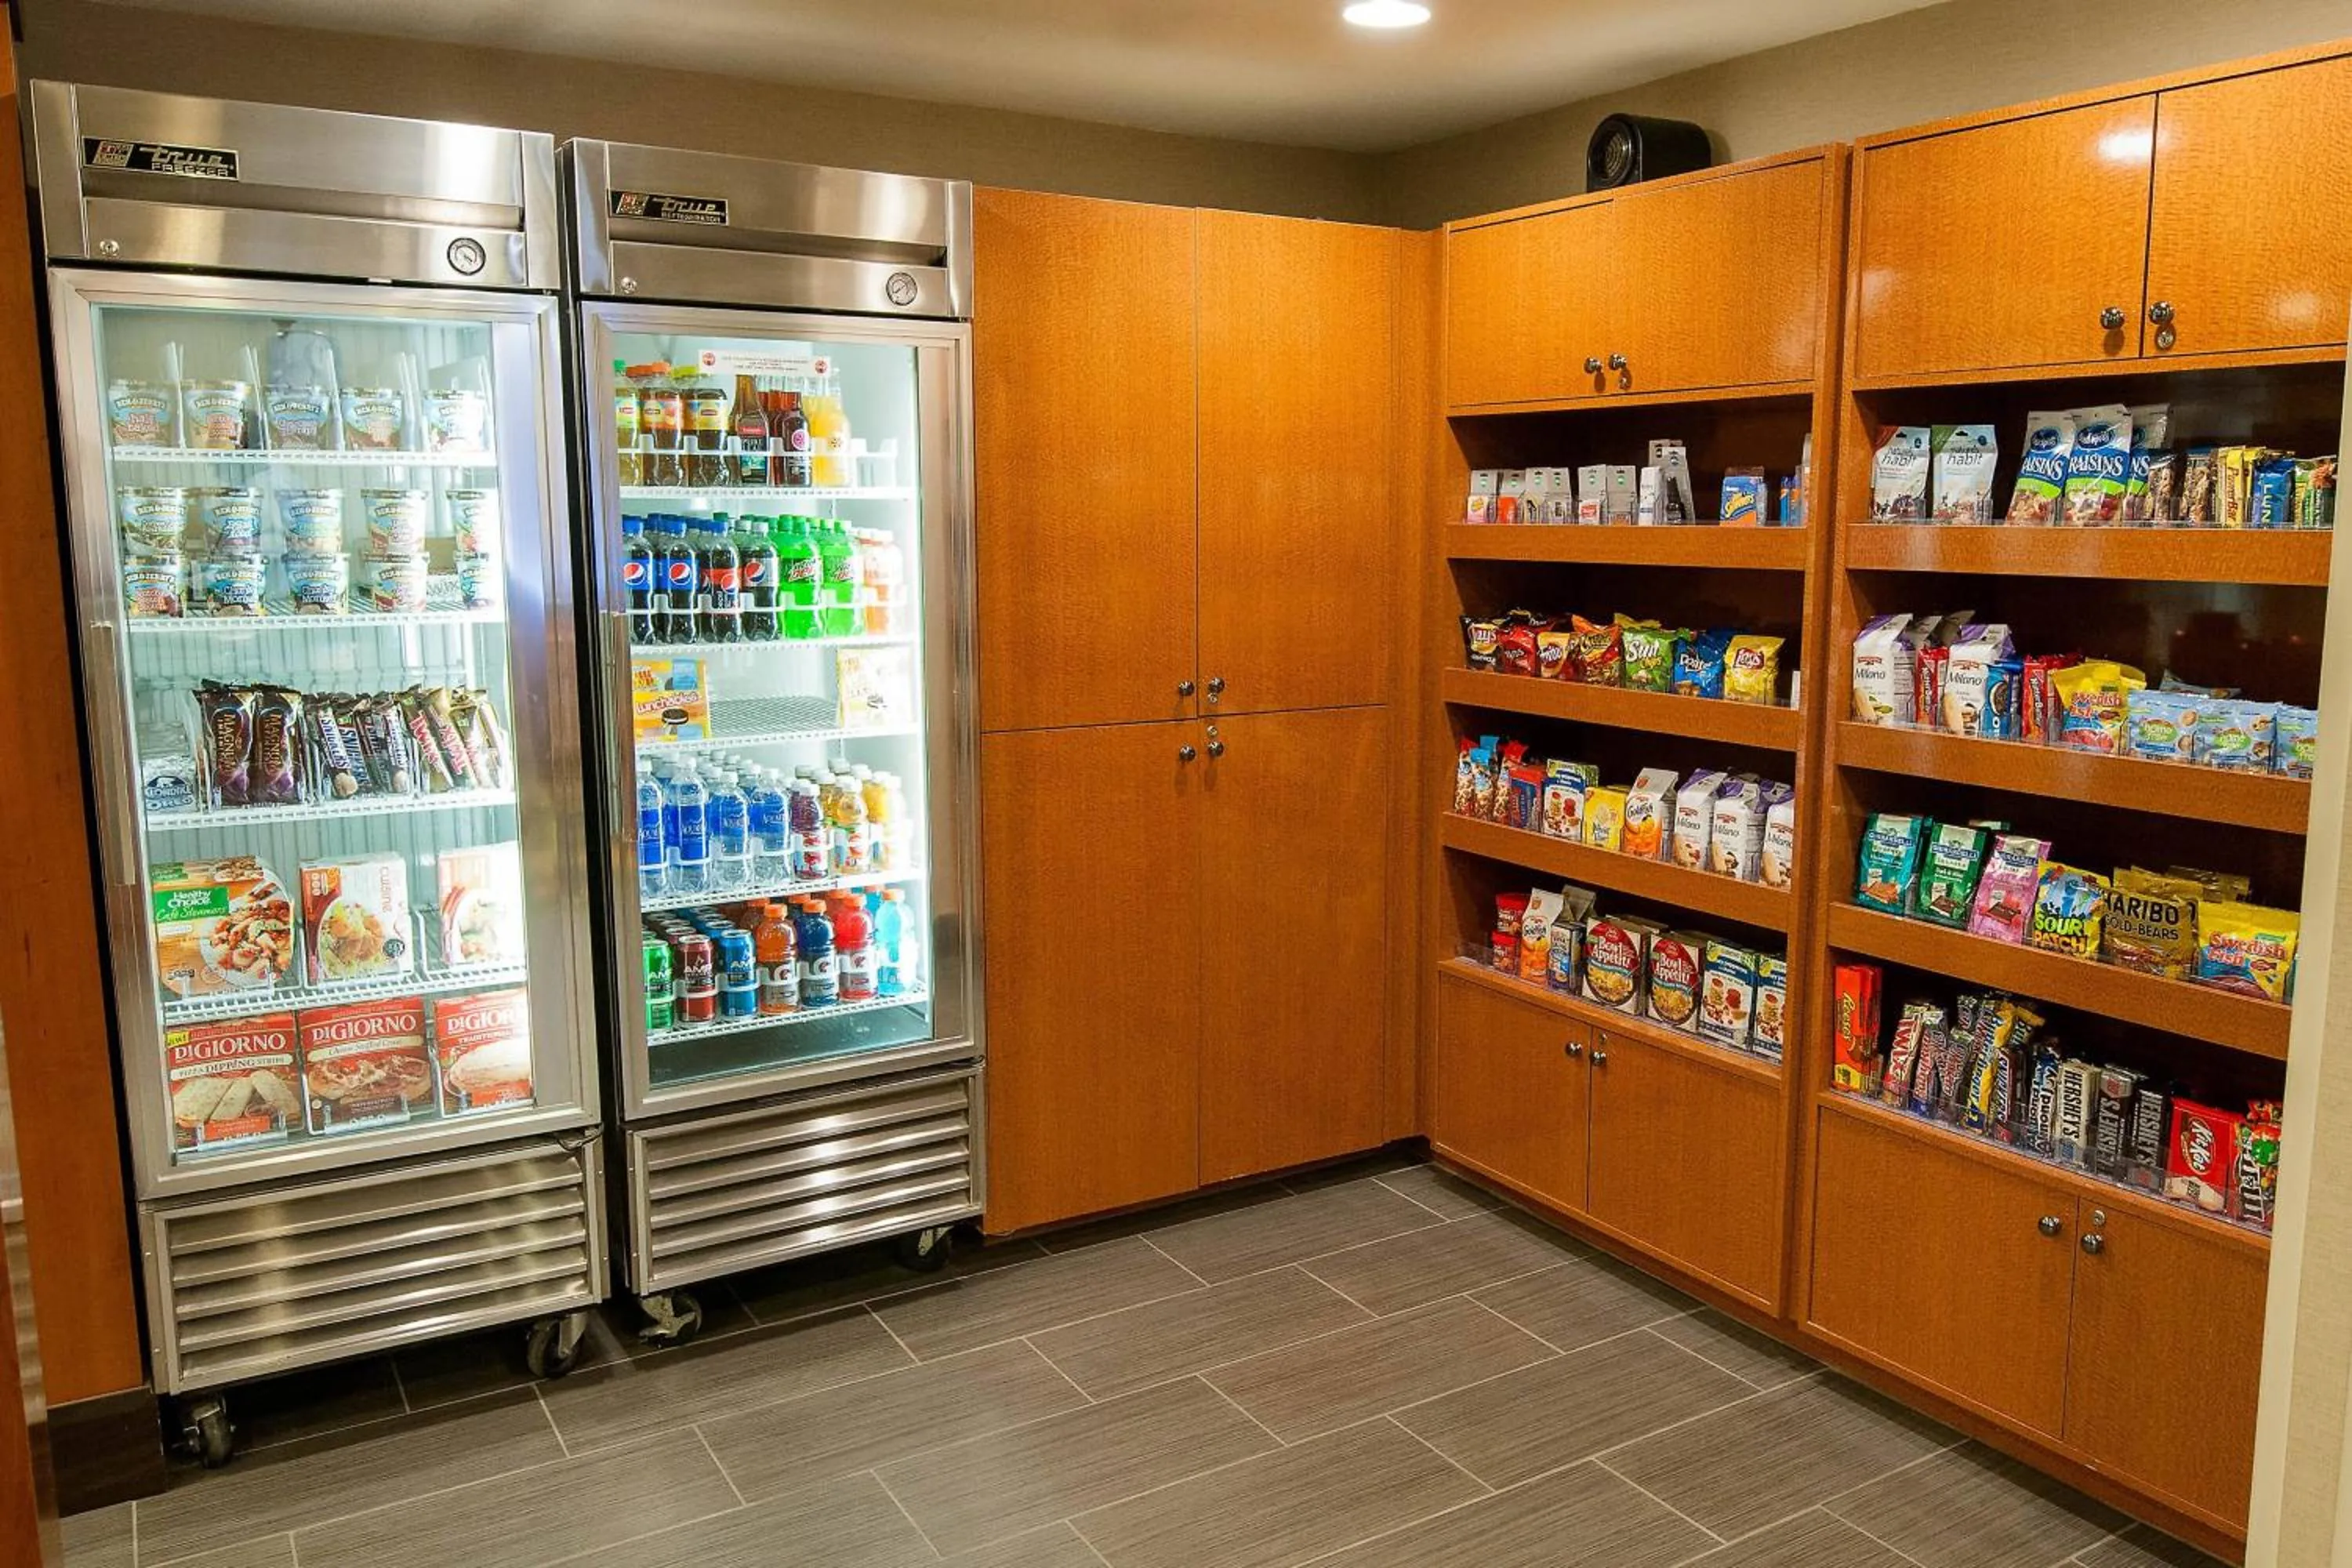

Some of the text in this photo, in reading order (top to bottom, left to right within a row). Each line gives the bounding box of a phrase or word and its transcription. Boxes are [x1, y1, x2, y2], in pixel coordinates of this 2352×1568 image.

[2068, 454, 2125, 477] RAISINS
[1625, 639, 1661, 662] Sun
[1855, 667, 1886, 681] Milano
[1947, 671, 1983, 686] Milano
[1676, 816, 1700, 830] Milano
[1715, 823, 1740, 837] Milano
[167, 897, 213, 908] Choice
[172, 890, 212, 902] Healthy
[2034, 911, 2085, 936] SOUR
[2104, 913, 2179, 940] GOLD-BEARS
[2034, 931, 2086, 954] PATCH
[2209, 931, 2286, 960] Swedish
[2207, 946, 2245, 967] Fish
[311, 1014, 417, 1043] DIGIORNO
[174, 1033, 287, 1061] DIGIORNO
[205, 1058, 256, 1073] DIPPING
[2062, 1069, 2083, 1139] HERSHEY'S
